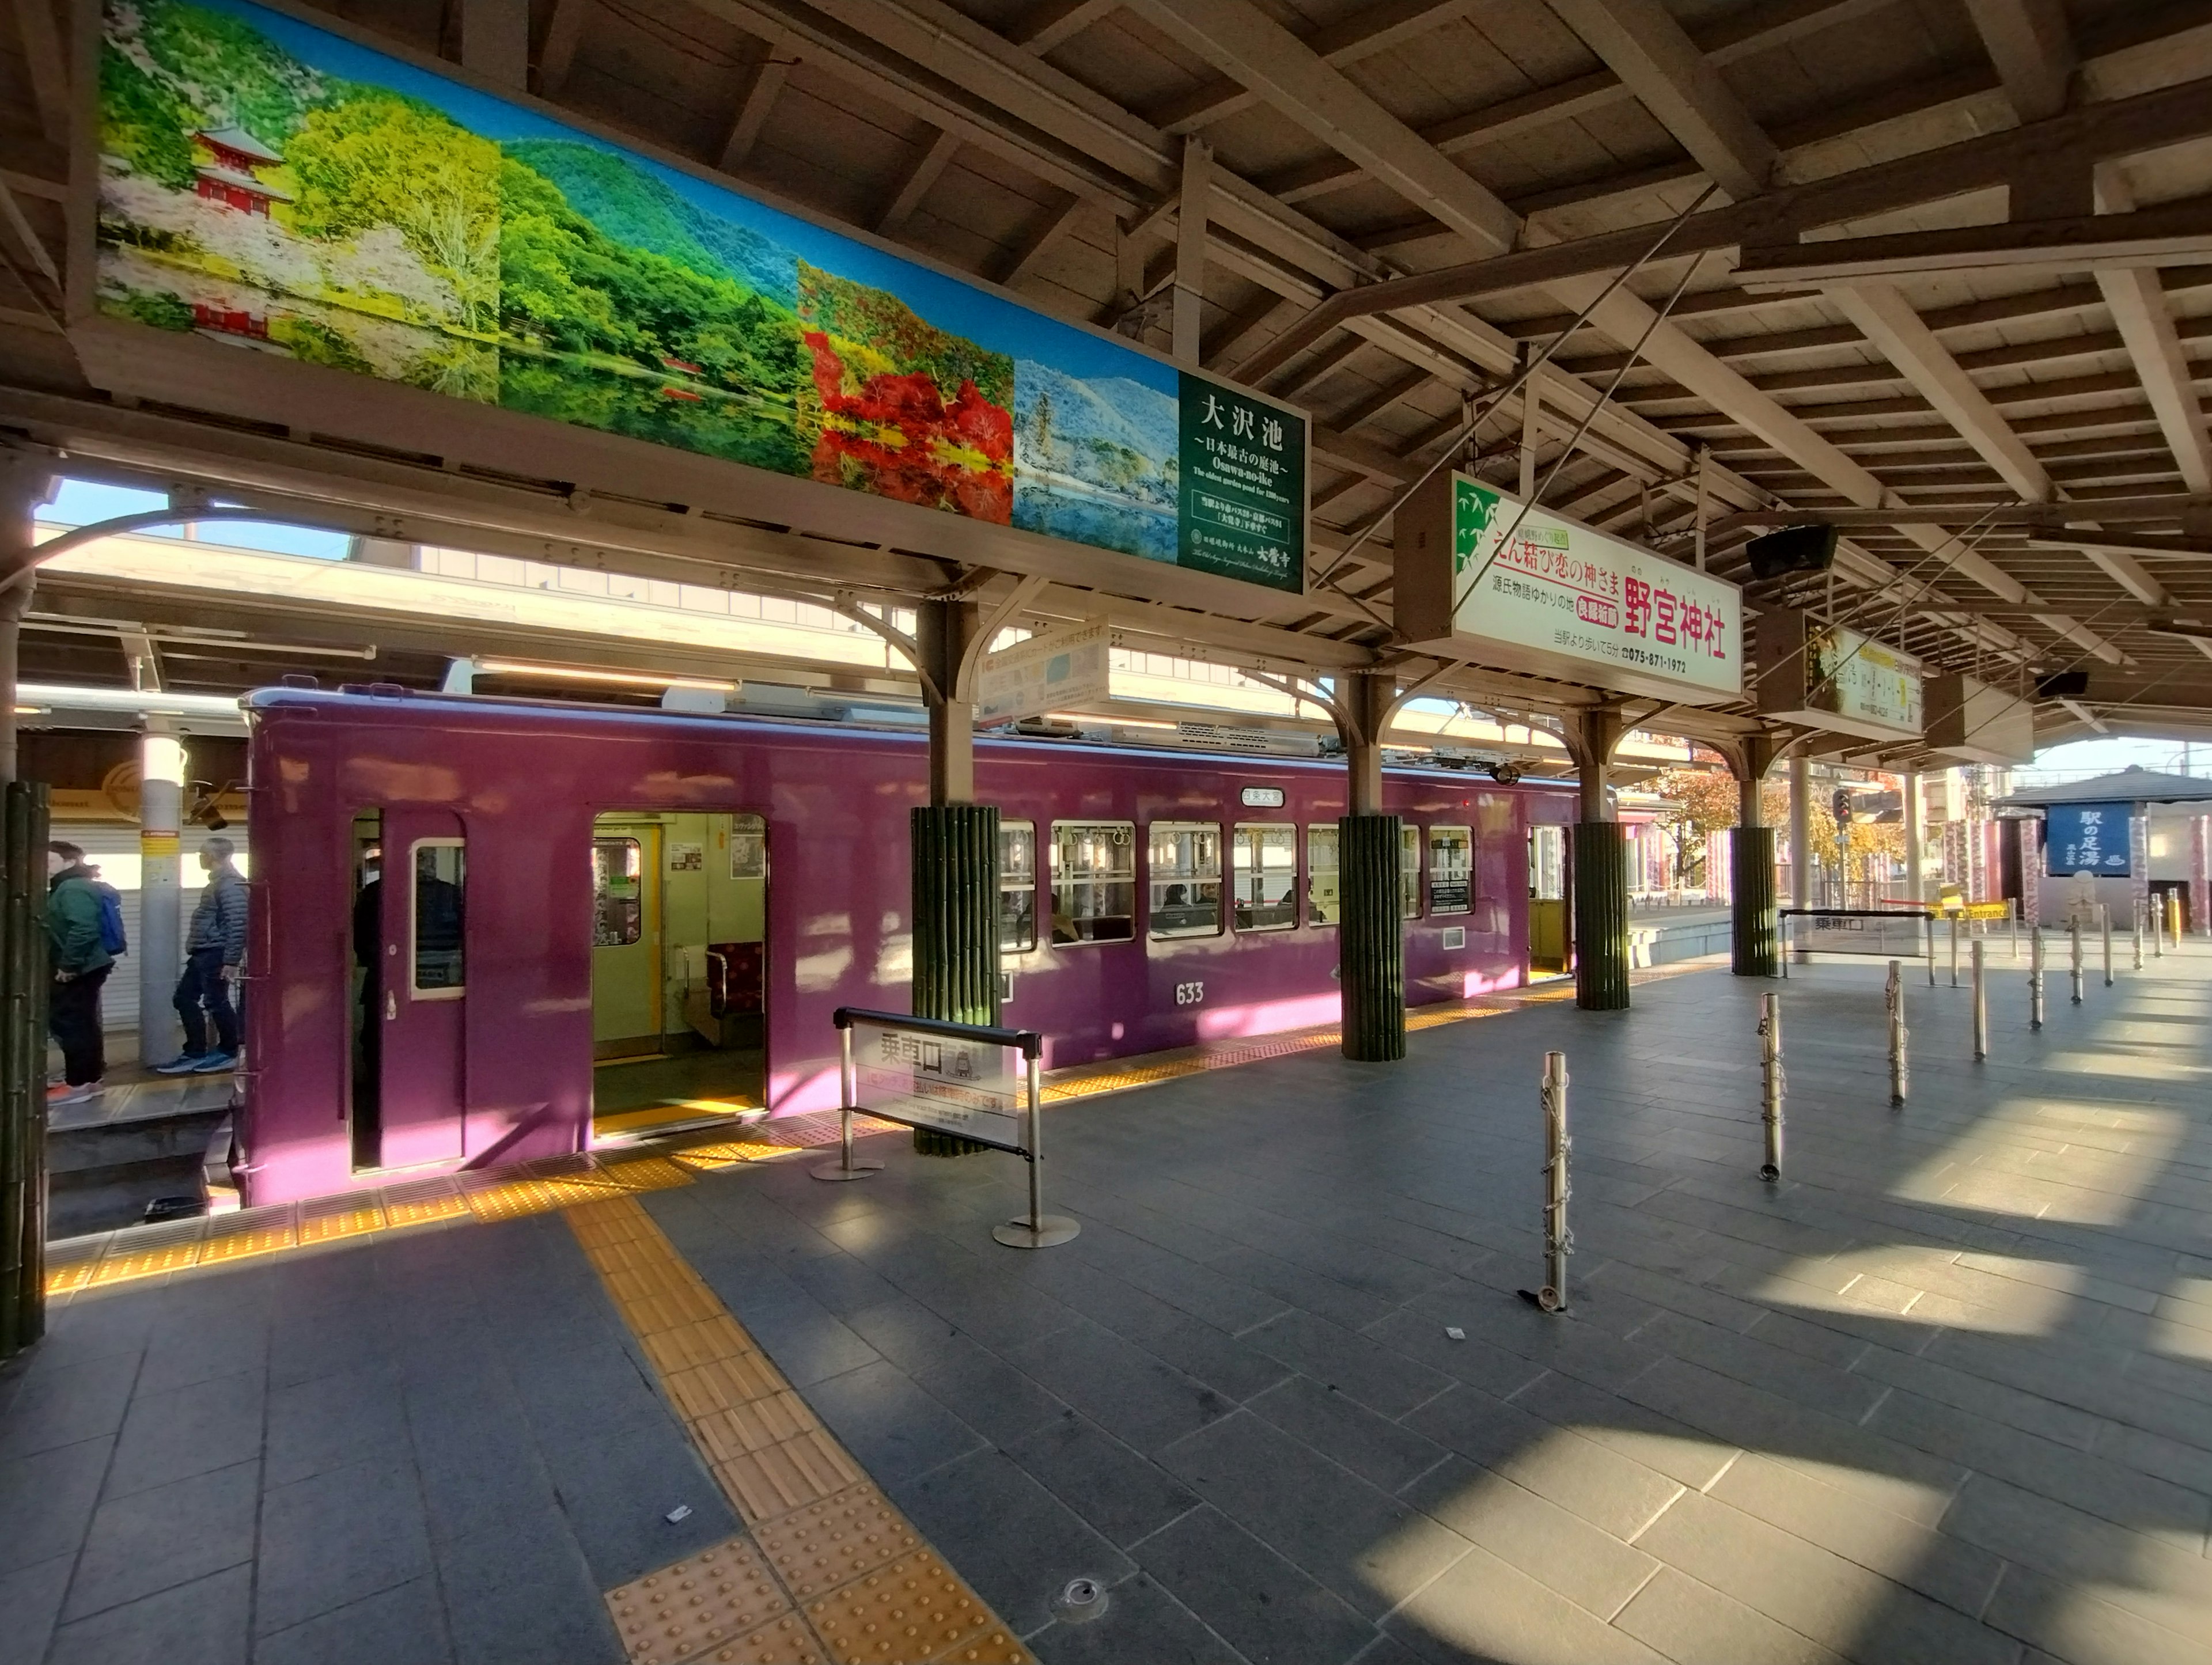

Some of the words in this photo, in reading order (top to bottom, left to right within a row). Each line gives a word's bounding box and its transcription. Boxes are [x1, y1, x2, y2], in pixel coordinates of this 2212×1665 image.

[1201, 393, 1283, 452] 大沢池
[1193, 466, 1205, 477] The
[1205, 471, 1222, 483] oldest
[1222, 478, 1241, 488] garden
[1242, 484, 1255, 494] pond
[1256, 487, 1265, 496] for
[1213, 456, 1272, 487] Osawa-no-ike
[1493, 574, 1574, 613] 源氏物語ゆかりの地
[1624, 576, 1726, 660] 野宮神社
[1554, 628, 1619, 658] 当駅より歩いて5分
[1243, 790, 1280, 802] 四条大宮
[2078, 811, 2104, 866] 駅の足湯
[1815, 917, 1864, 932] 乗車口
[1969, 908, 2008, 919] Entrance
[1175, 980, 1204, 1005] 633
[881, 1033, 942, 1075] 乗車口
